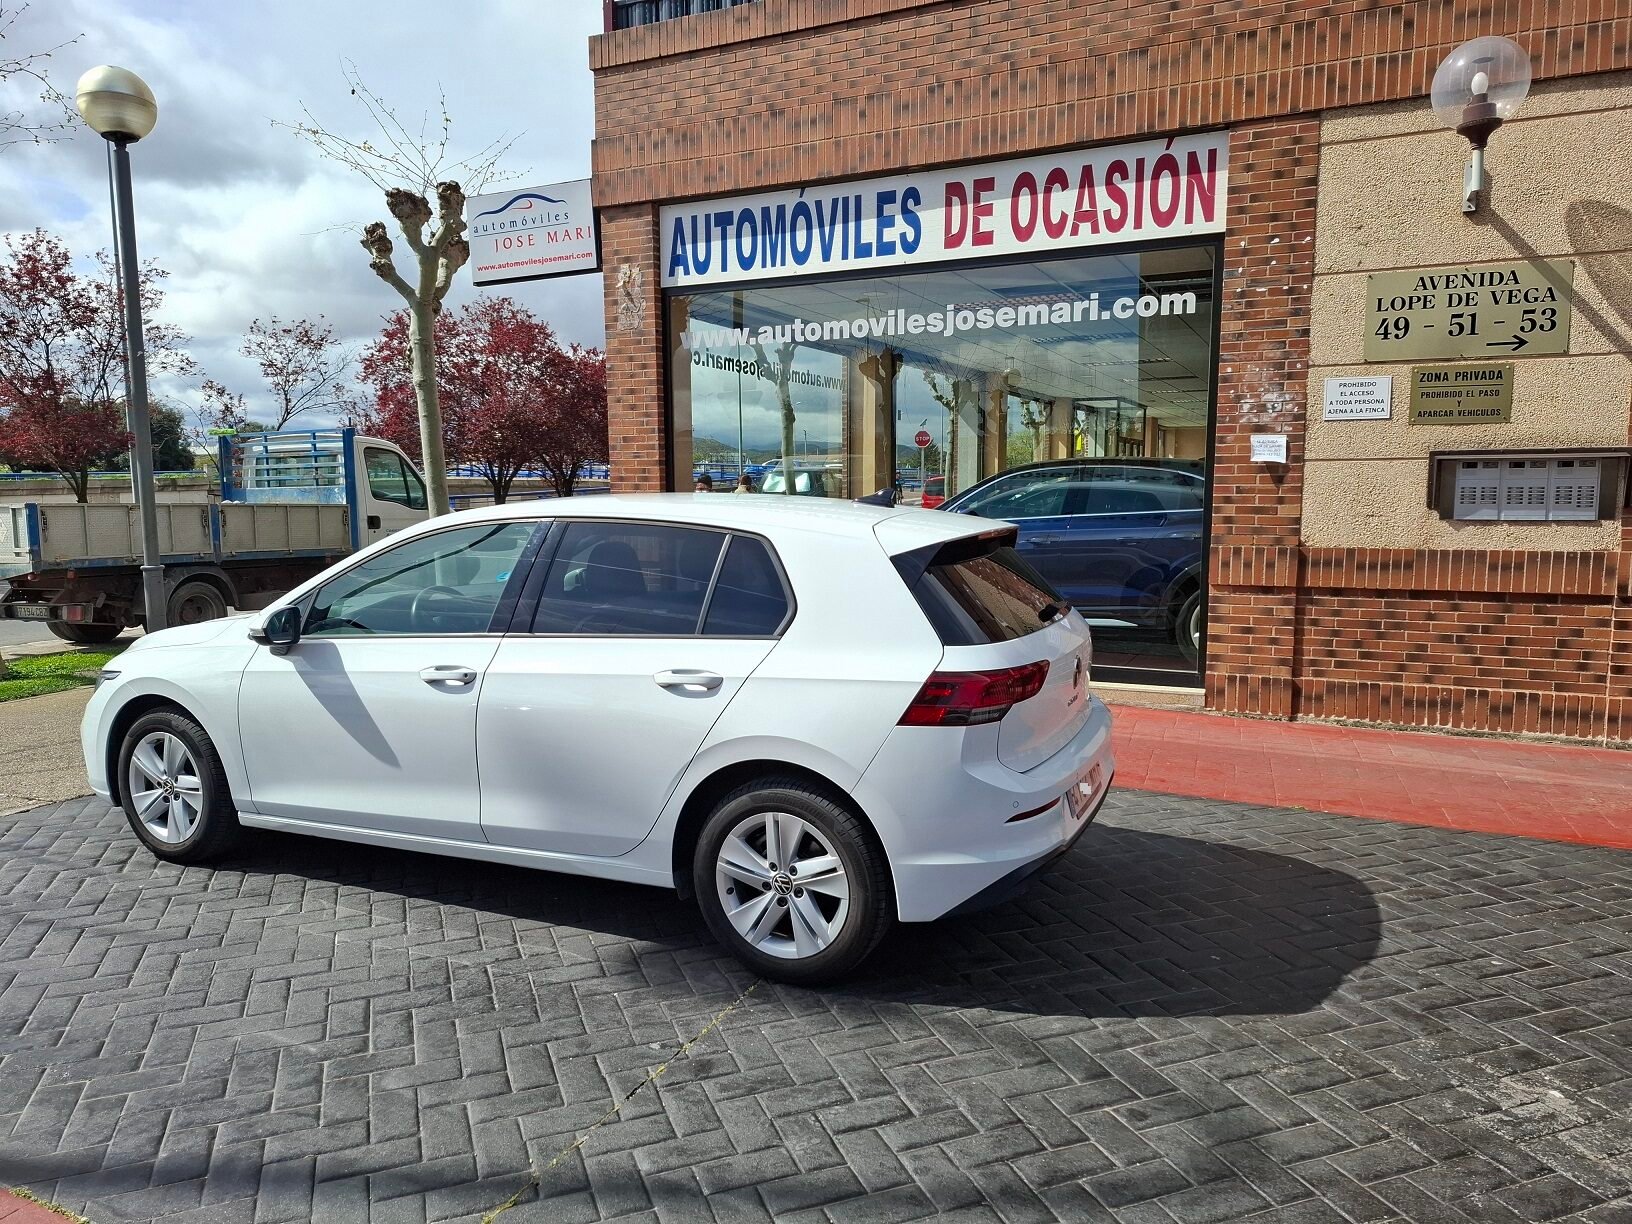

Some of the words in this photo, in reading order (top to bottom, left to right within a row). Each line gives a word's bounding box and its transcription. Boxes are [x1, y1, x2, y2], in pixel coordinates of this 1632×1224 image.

[668, 186, 922, 278] AUTOMÓVILES
[944, 176, 996, 249] DE
[1010, 137, 1218, 243] OCASIÓN
[473, 211, 570, 234] automóviles
[495, 234, 536, 253] JOSE
[547, 225, 592, 244] MARI
[477, 252, 593, 272] www.automovilesjosemari.com
[1413, 269, 1521, 292] AVENIDA
[1375, 294, 1436, 312] LOPE
[1446, 291, 1479, 308] DE
[1490, 286, 1558, 306] VEGA
[680, 291, 1197, 350] www.automovilesjosemari.com
[1374, 316, 1410, 341] 49
[1447, 312, 1480, 337] 51
[1519, 307, 1557, 333] 53
[1419, 371, 1449, 383] ZONA
[1454, 369, 1503, 381] PRIVADA
[1420, 390, 1463, 399] PROHIBIDO
[1466, 390, 1475, 398] EL
[1478, 389, 1500, 397] PASO
[1417, 409, 1454, 417] APARCAR
[1457, 408, 1501, 417] VEHICULOS
